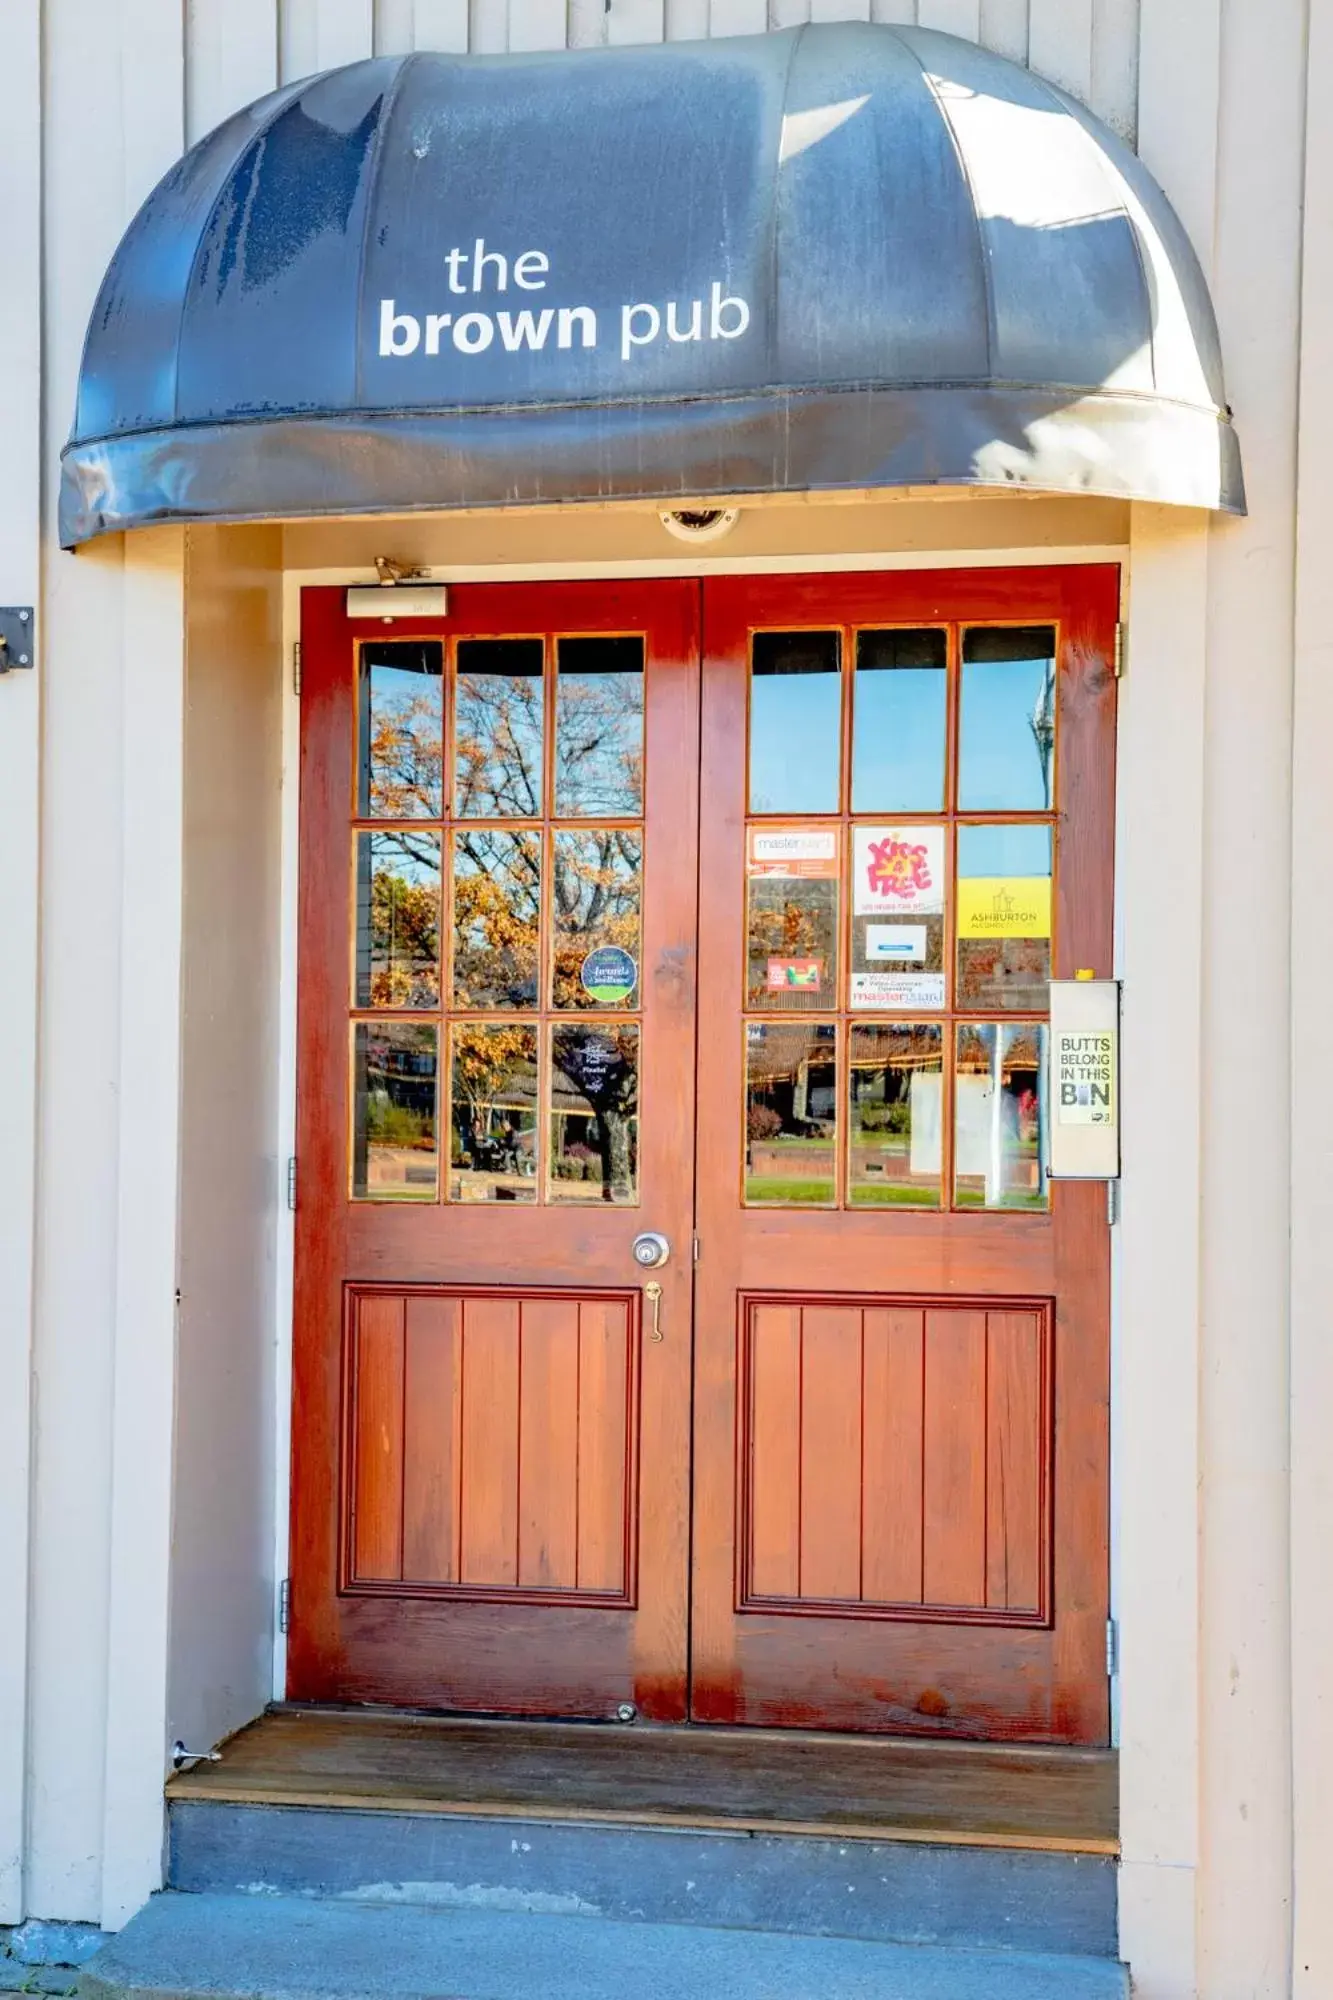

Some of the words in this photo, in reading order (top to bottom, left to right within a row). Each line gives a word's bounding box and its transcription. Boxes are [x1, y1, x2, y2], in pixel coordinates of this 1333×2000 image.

[444, 238, 550, 295] the
[378, 299, 597, 357] brown
[620, 282, 751, 361] pub
[970, 912, 1038, 922] ASHBURTON
[1061, 1038, 1110, 1051] BUTTS
[1060, 1054, 1110, 1064] BELONG
[1060, 1068, 1074, 1080] IN
[1078, 1068, 1110, 1080] THIS
